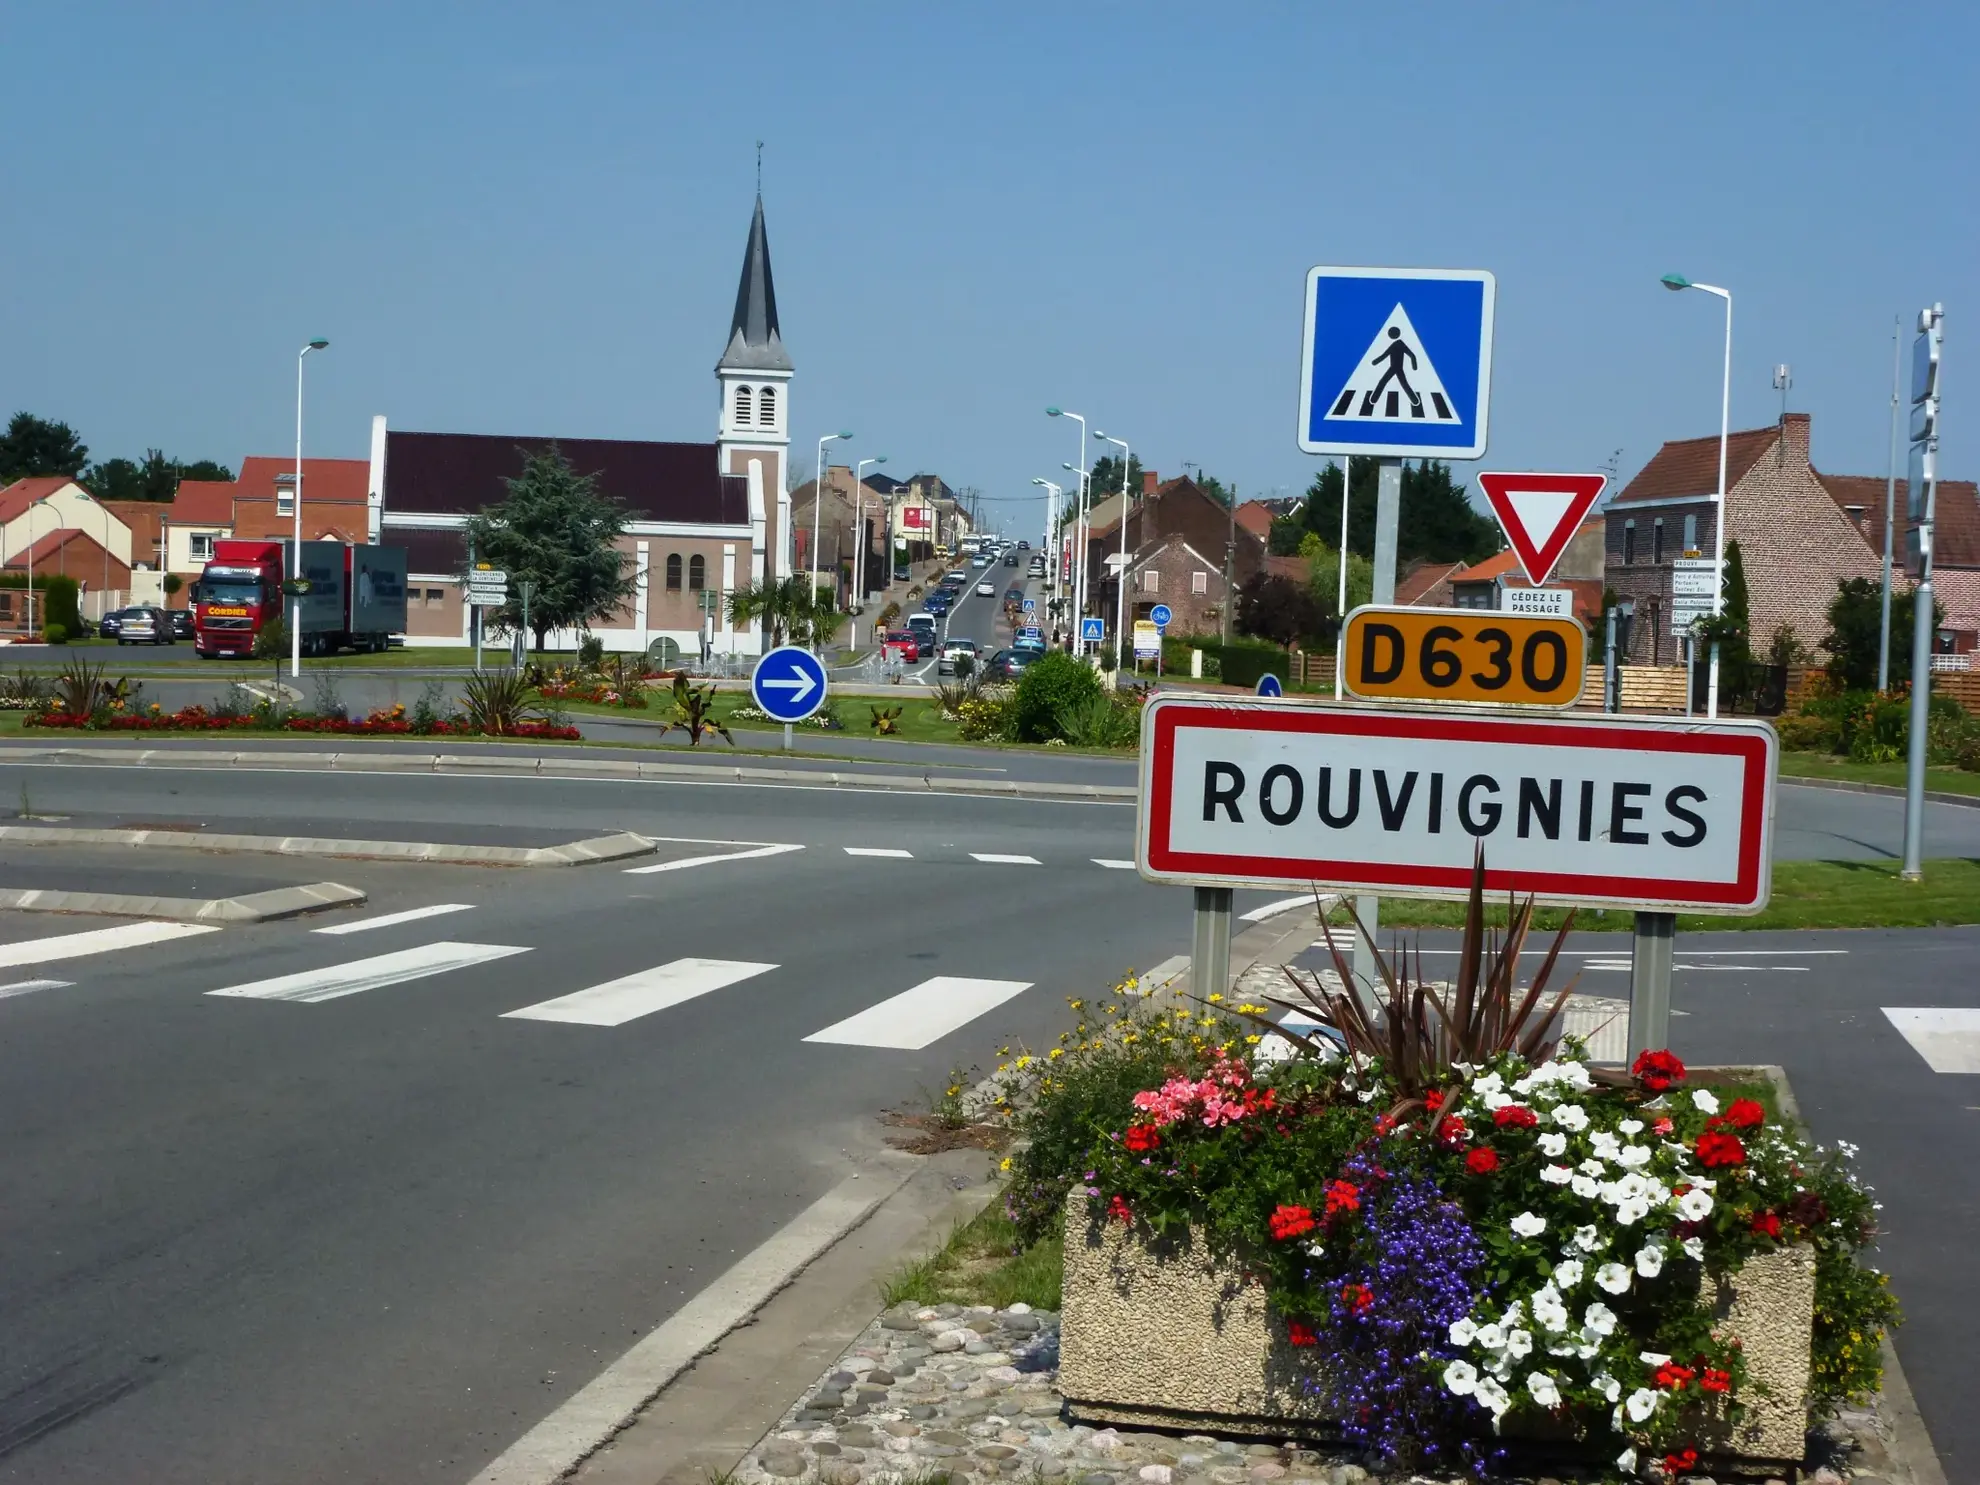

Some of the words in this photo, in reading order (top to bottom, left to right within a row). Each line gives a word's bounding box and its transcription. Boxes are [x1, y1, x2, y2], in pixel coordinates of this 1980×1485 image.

[1511, 592, 1546, 602] CÉDEZ
[1549, 594, 1562, 603] LE
[208, 607, 247, 616] CORDIER
[1512, 604, 1560, 614] PASSAGE
[1202, 760, 1708, 848] ROUVIGNIES
